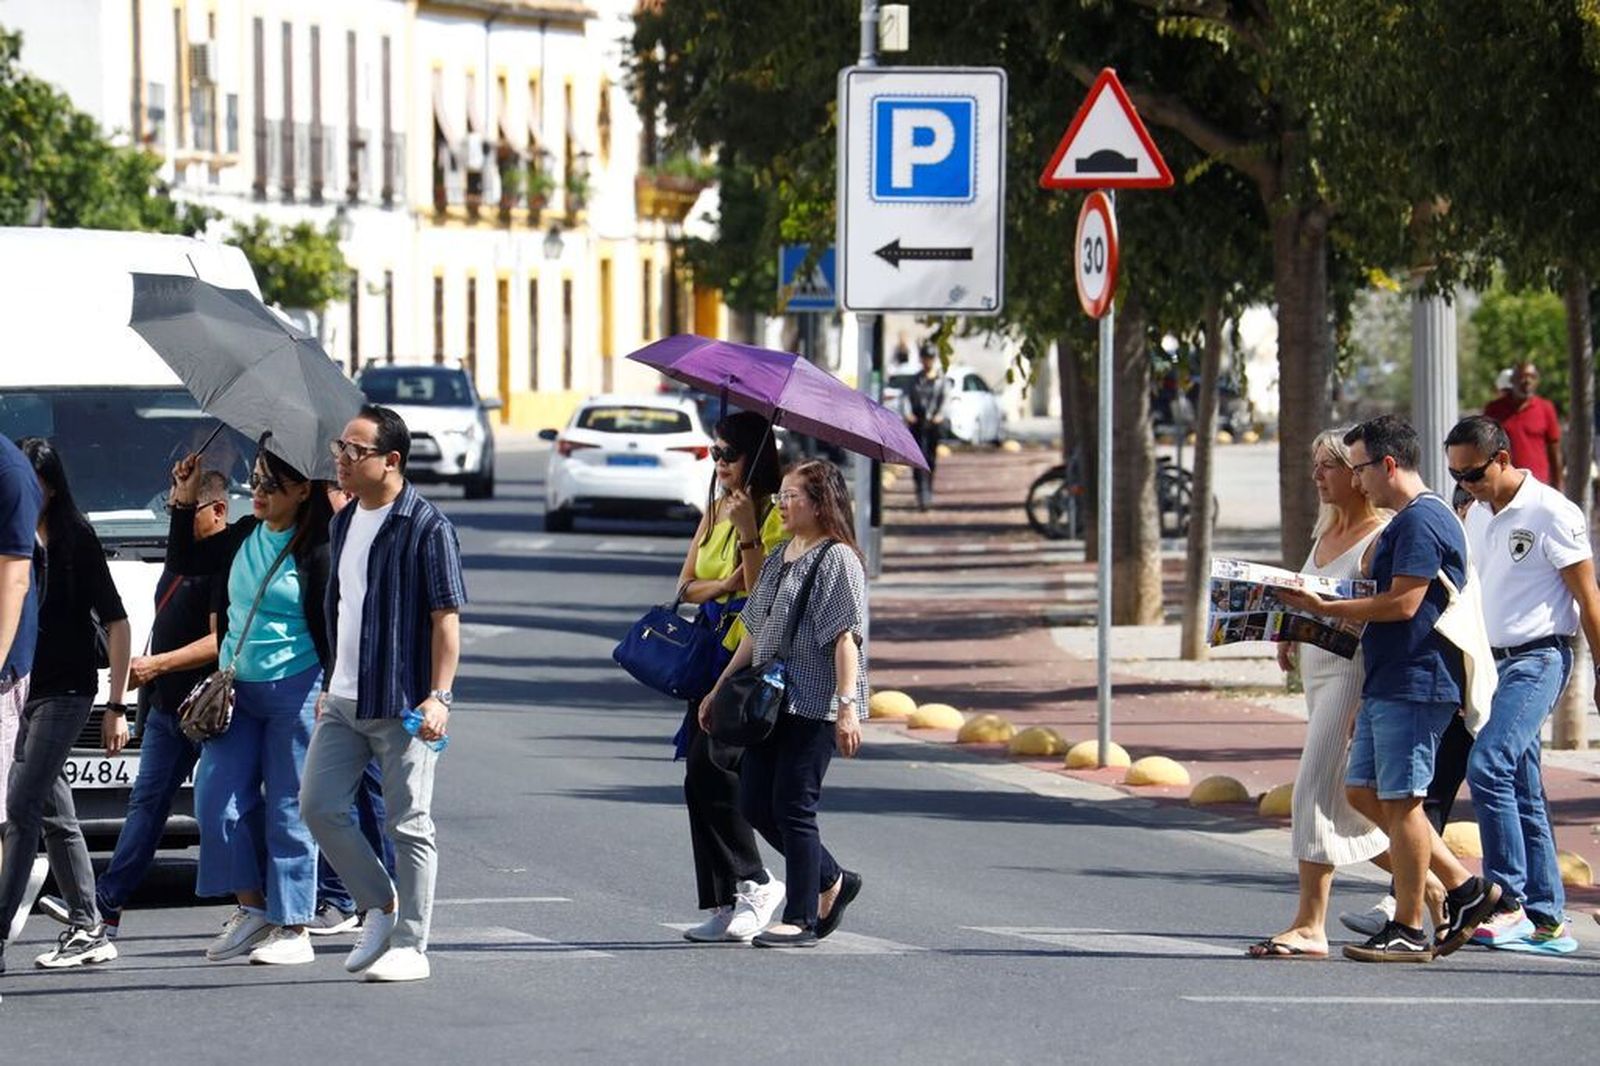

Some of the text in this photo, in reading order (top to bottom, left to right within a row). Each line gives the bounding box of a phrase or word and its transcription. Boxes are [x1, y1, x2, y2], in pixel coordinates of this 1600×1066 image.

[891, 108, 955, 189] P
[1083, 237, 1104, 275] 30
[65, 760, 129, 784] 9484
